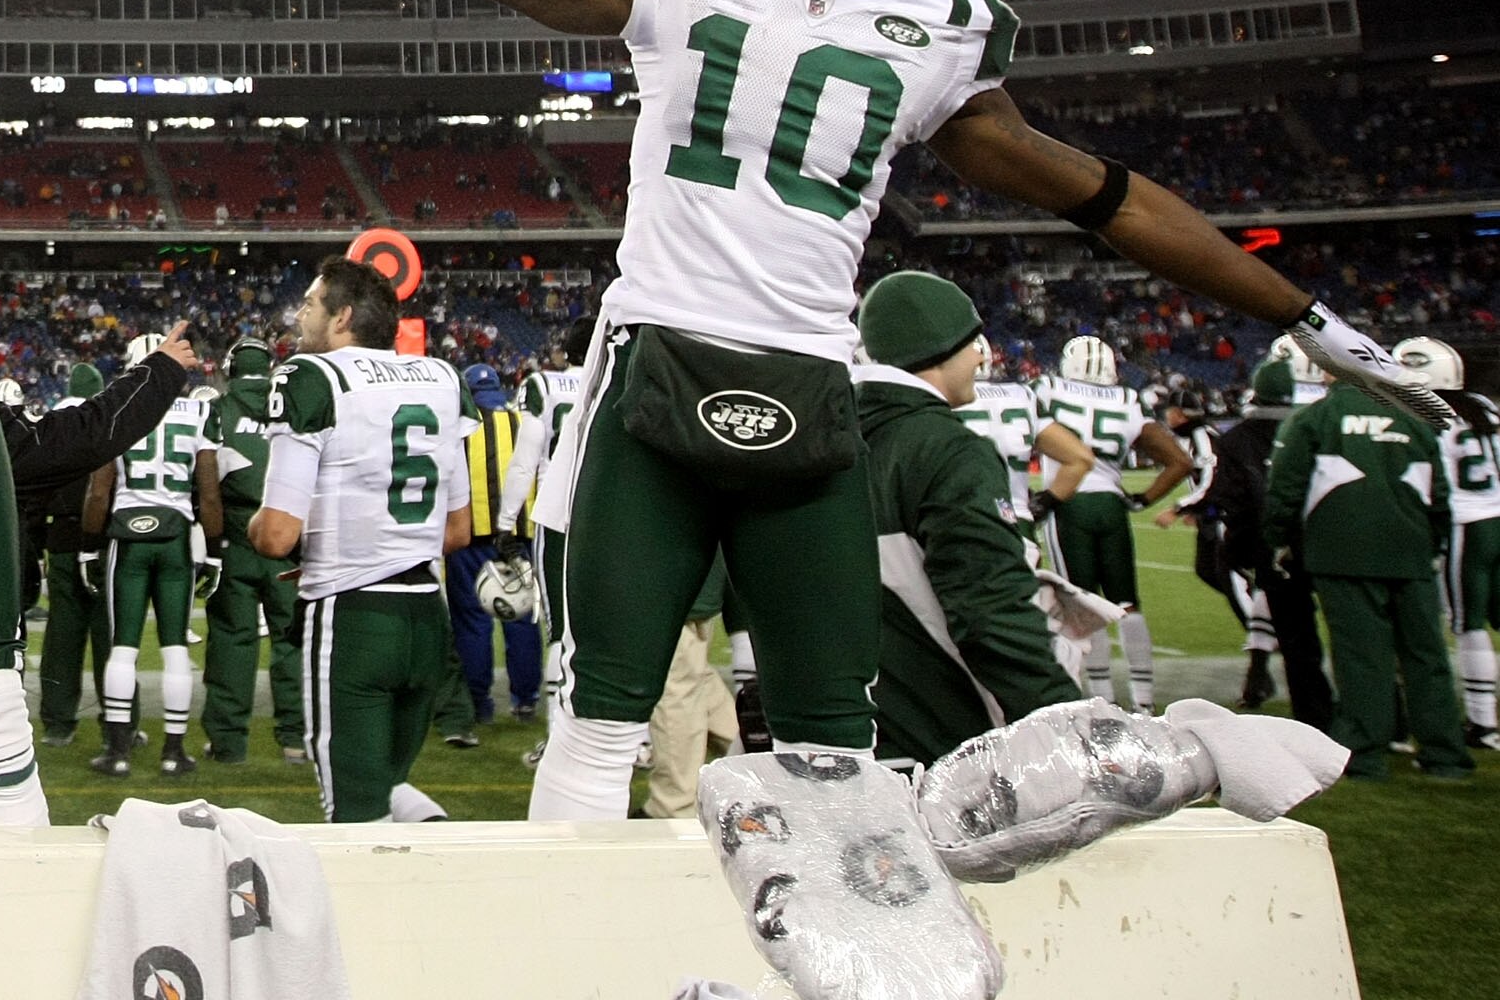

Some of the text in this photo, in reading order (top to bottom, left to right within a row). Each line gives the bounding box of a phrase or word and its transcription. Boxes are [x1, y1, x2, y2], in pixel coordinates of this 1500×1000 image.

[665, 12, 905, 221] 10
[354, 358, 439, 384] SANCHEZ
[269, 375, 289, 418] 6
[711, 407, 778, 430] JETS
[387, 403, 440, 524] 6
